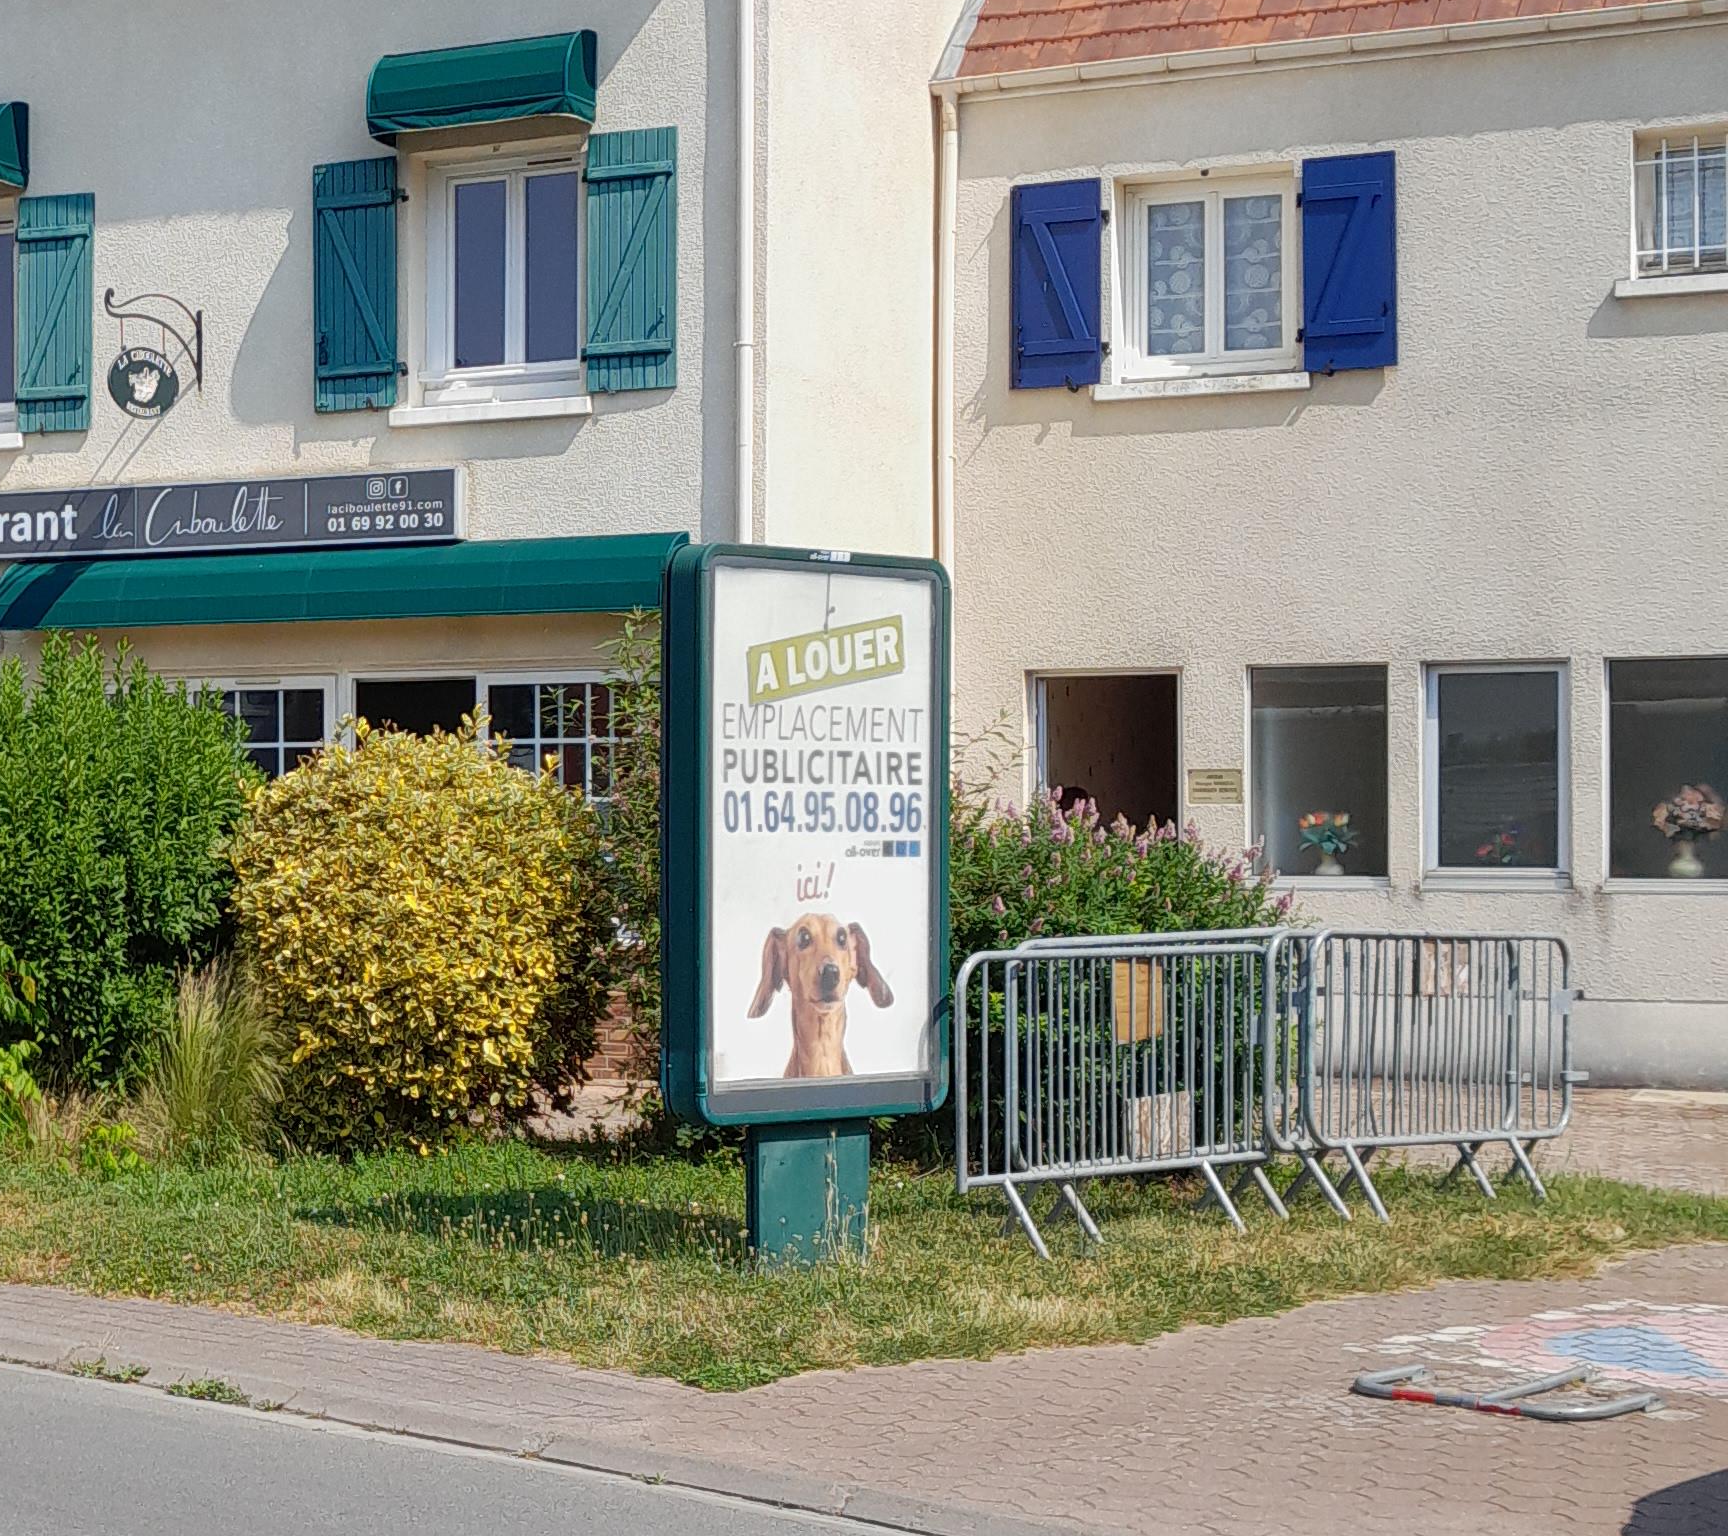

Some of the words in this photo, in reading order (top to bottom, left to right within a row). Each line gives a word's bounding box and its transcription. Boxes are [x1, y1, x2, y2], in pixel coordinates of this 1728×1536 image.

[145, 486, 284, 546] Ciboulette
[327, 500, 443, 514] laciboulette91.com
[327, 517, 347, 532] 01
[351, 516, 370, 531] 69
[375, 515, 394, 530] 92
[399, 514, 419, 529] 00
[424, 512, 443, 528] 30
[755, 651, 780, 695] A
[786, 626, 899, 687] LOUER
[722, 702, 924, 743] EMPLACEMENT
[722, 748, 923, 786] PUBLICITAIRE
[723, 790, 922, 833] 01.64.95.08.96
